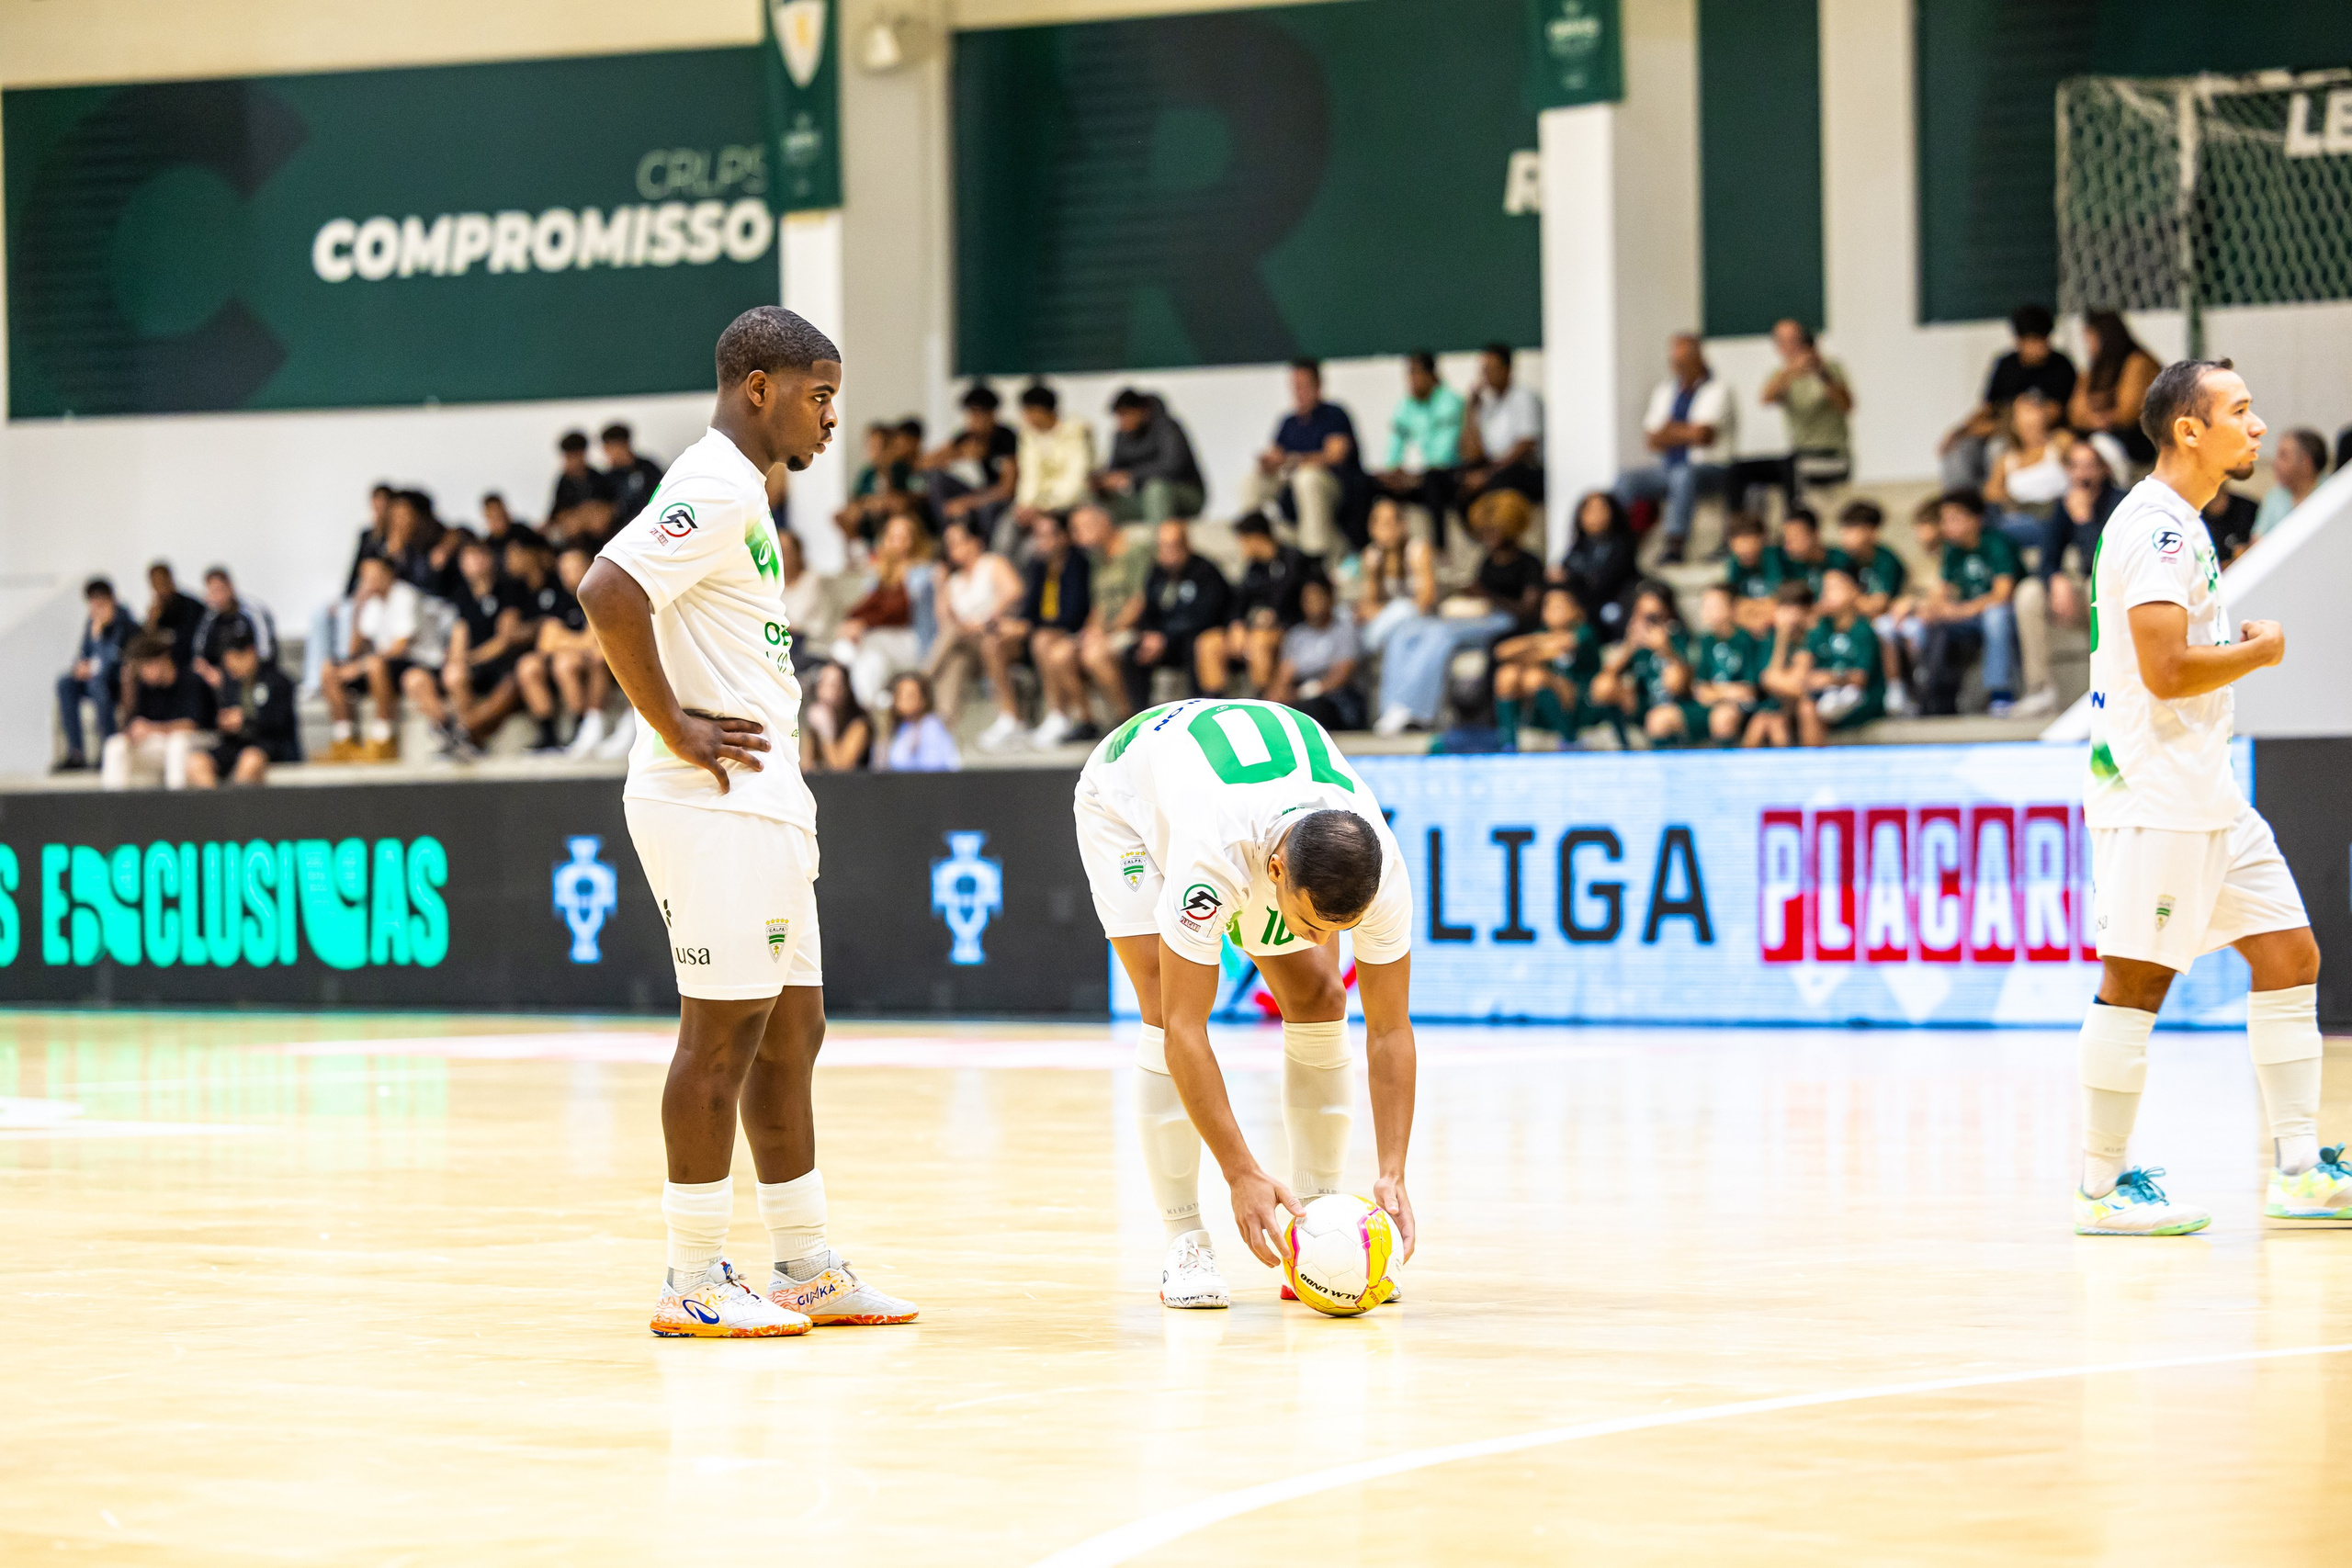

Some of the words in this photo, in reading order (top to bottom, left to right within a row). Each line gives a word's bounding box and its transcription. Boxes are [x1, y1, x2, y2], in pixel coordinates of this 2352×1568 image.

[312, 197, 773, 282] COMPROMISSO
[1188, 704, 1355, 795] 10
[1426, 825, 1715, 946] LIGA
